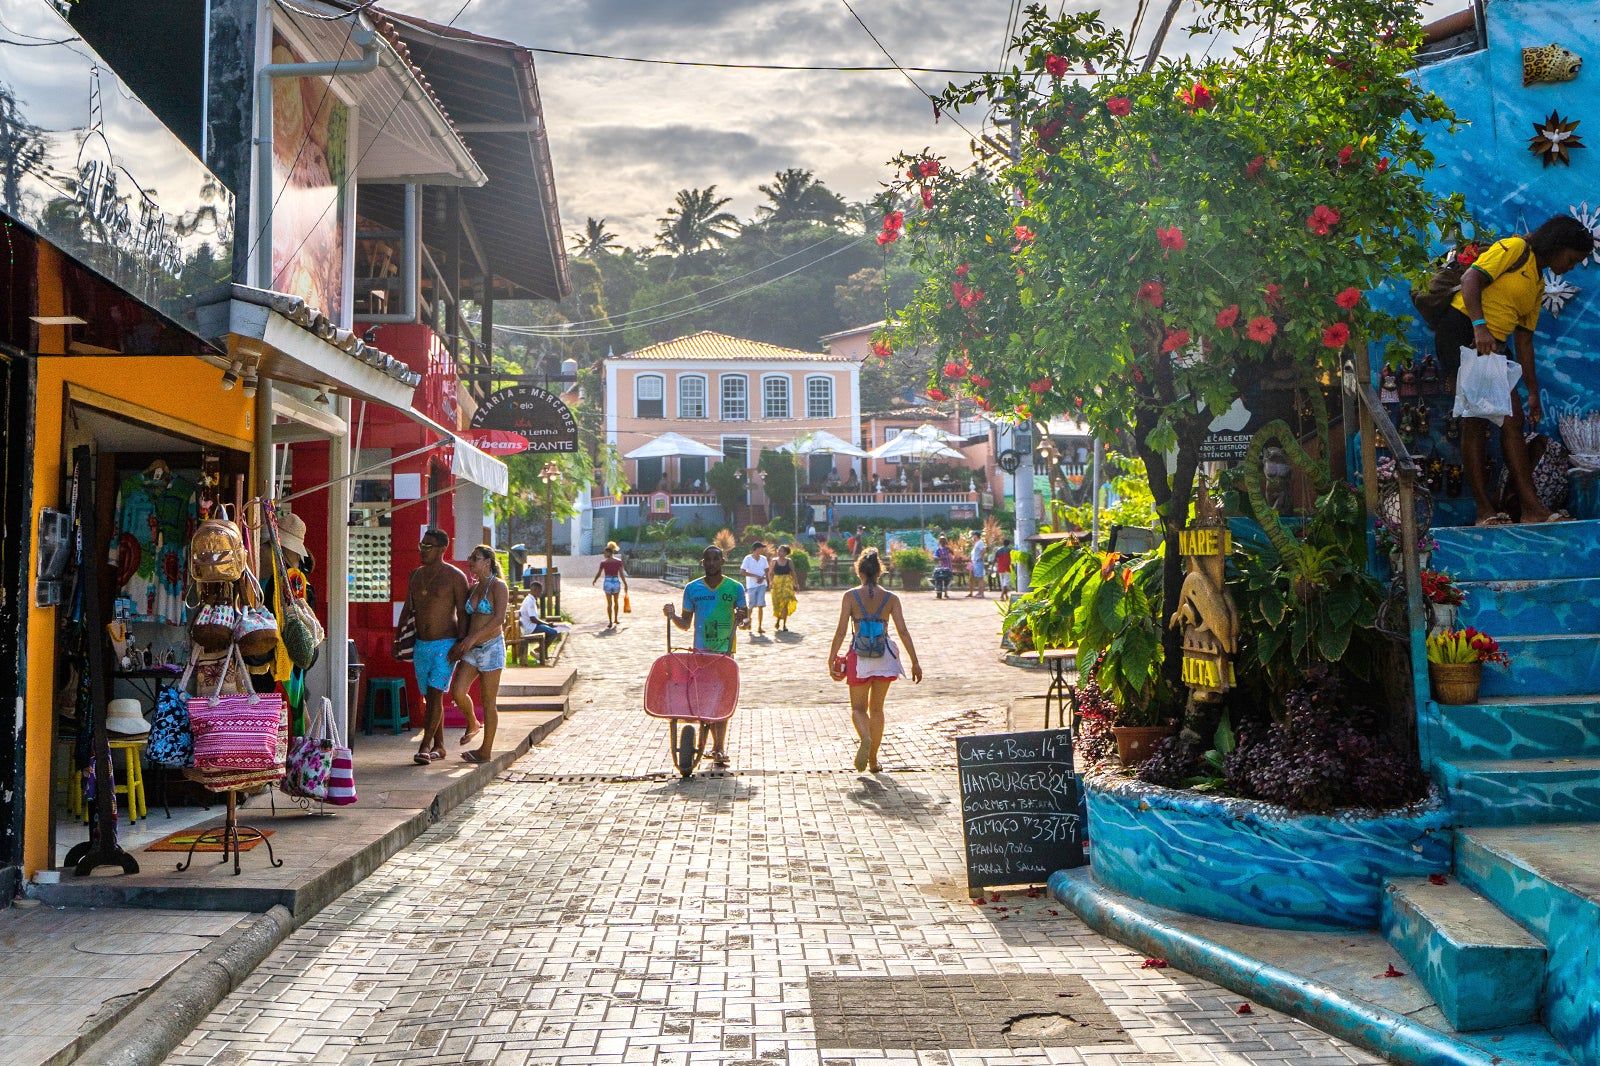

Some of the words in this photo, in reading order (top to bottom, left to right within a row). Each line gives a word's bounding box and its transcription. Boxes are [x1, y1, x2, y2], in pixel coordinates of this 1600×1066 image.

[473, 389, 514, 428] IZZARIA
[531, 388, 576, 433] MERCEDES
[481, 440, 523, 450] beans
[526, 440, 573, 451] RANTE
[1233, 434, 1254, 442] CENT
[1181, 656, 1217, 688] ALTA
[961, 769, 1048, 795] HAMBURGER
[963, 795, 1010, 812] GOURMET
[969, 818, 1019, 837] ALMOÇO
